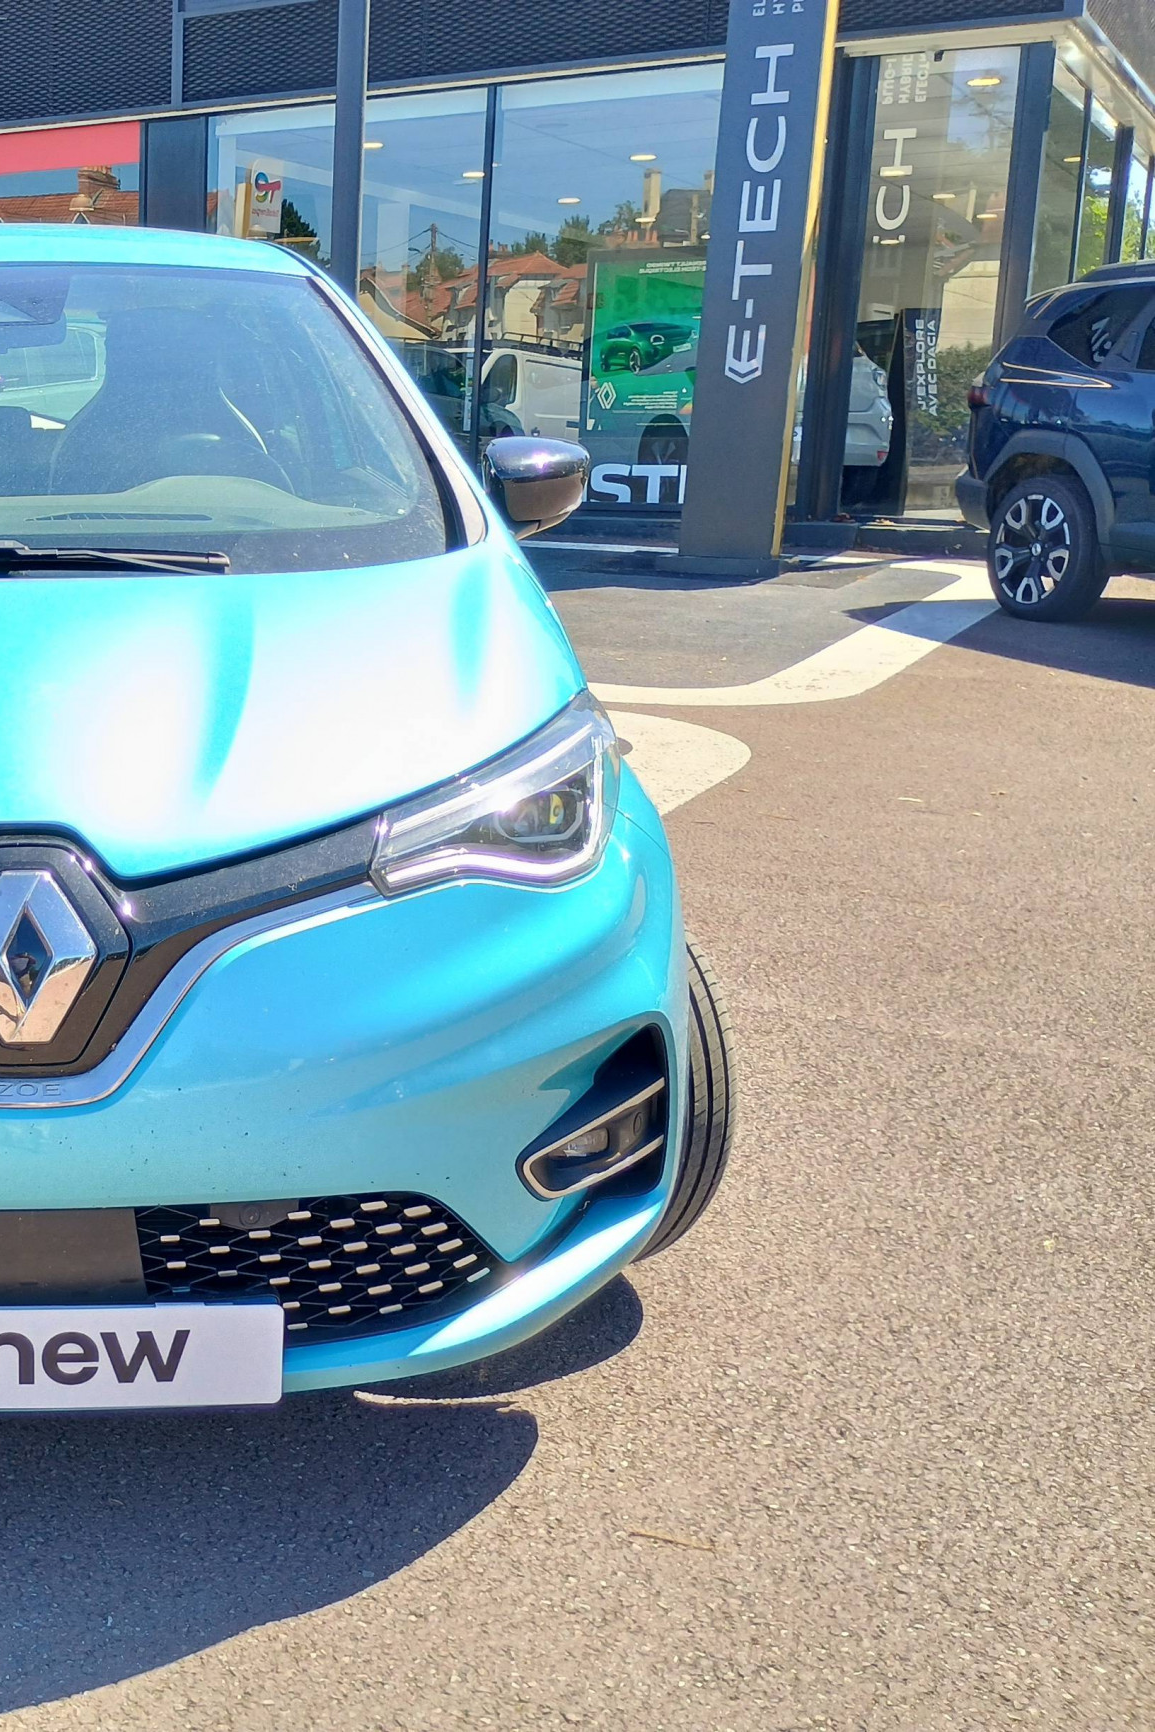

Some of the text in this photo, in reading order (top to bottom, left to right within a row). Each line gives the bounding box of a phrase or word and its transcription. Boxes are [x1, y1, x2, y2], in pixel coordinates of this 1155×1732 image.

[724, 43, 795, 384] E-TECH
[915, 318, 927, 411] J'EXPLORE
[926, 319, 938, 417] AVEC DACIA
